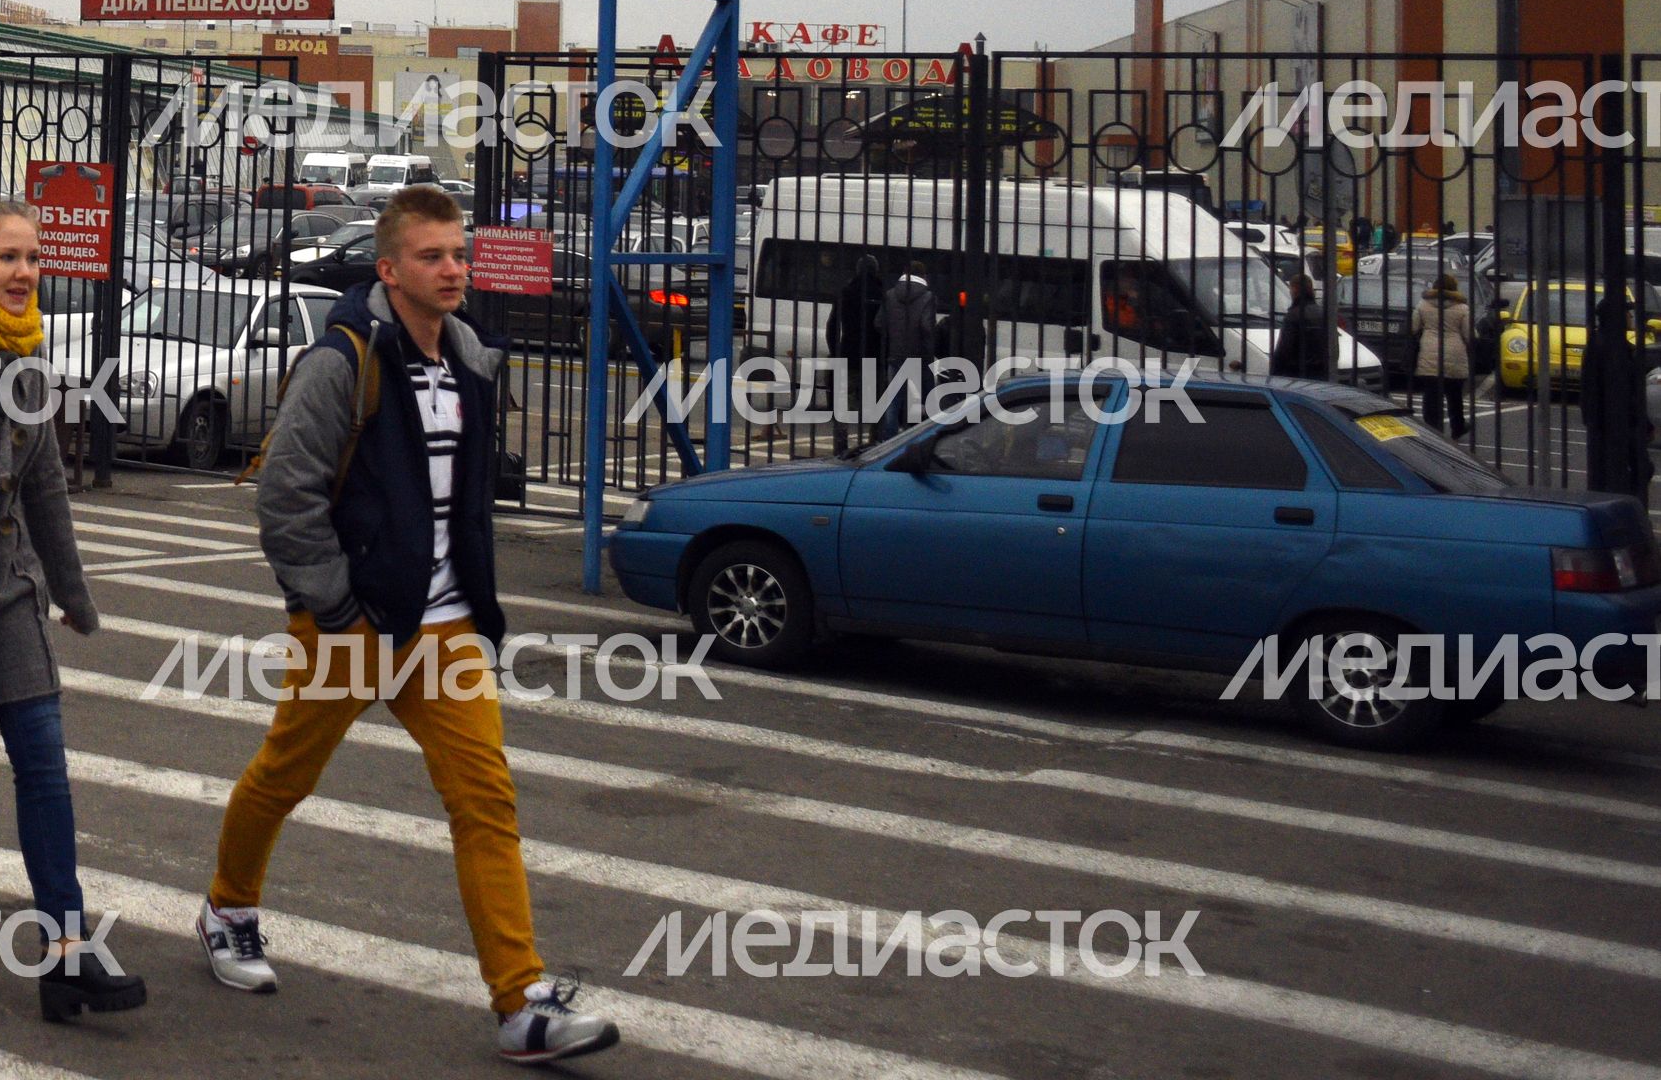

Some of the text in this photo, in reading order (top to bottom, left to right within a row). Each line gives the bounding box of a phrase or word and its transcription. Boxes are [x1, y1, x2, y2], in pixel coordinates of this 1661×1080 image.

[751, 21, 879, 46] КАФЕ
[274, 38, 328, 55] ВХОД
[475, 227, 536, 241] НИМАНИЕ
[60, 246, 99, 259] ВИДЕО-
[39, 259, 108, 273] БЛЮДЕНИЕМ
[472, 271, 550, 283] НУТРИОБЪЕКТОВОГО
